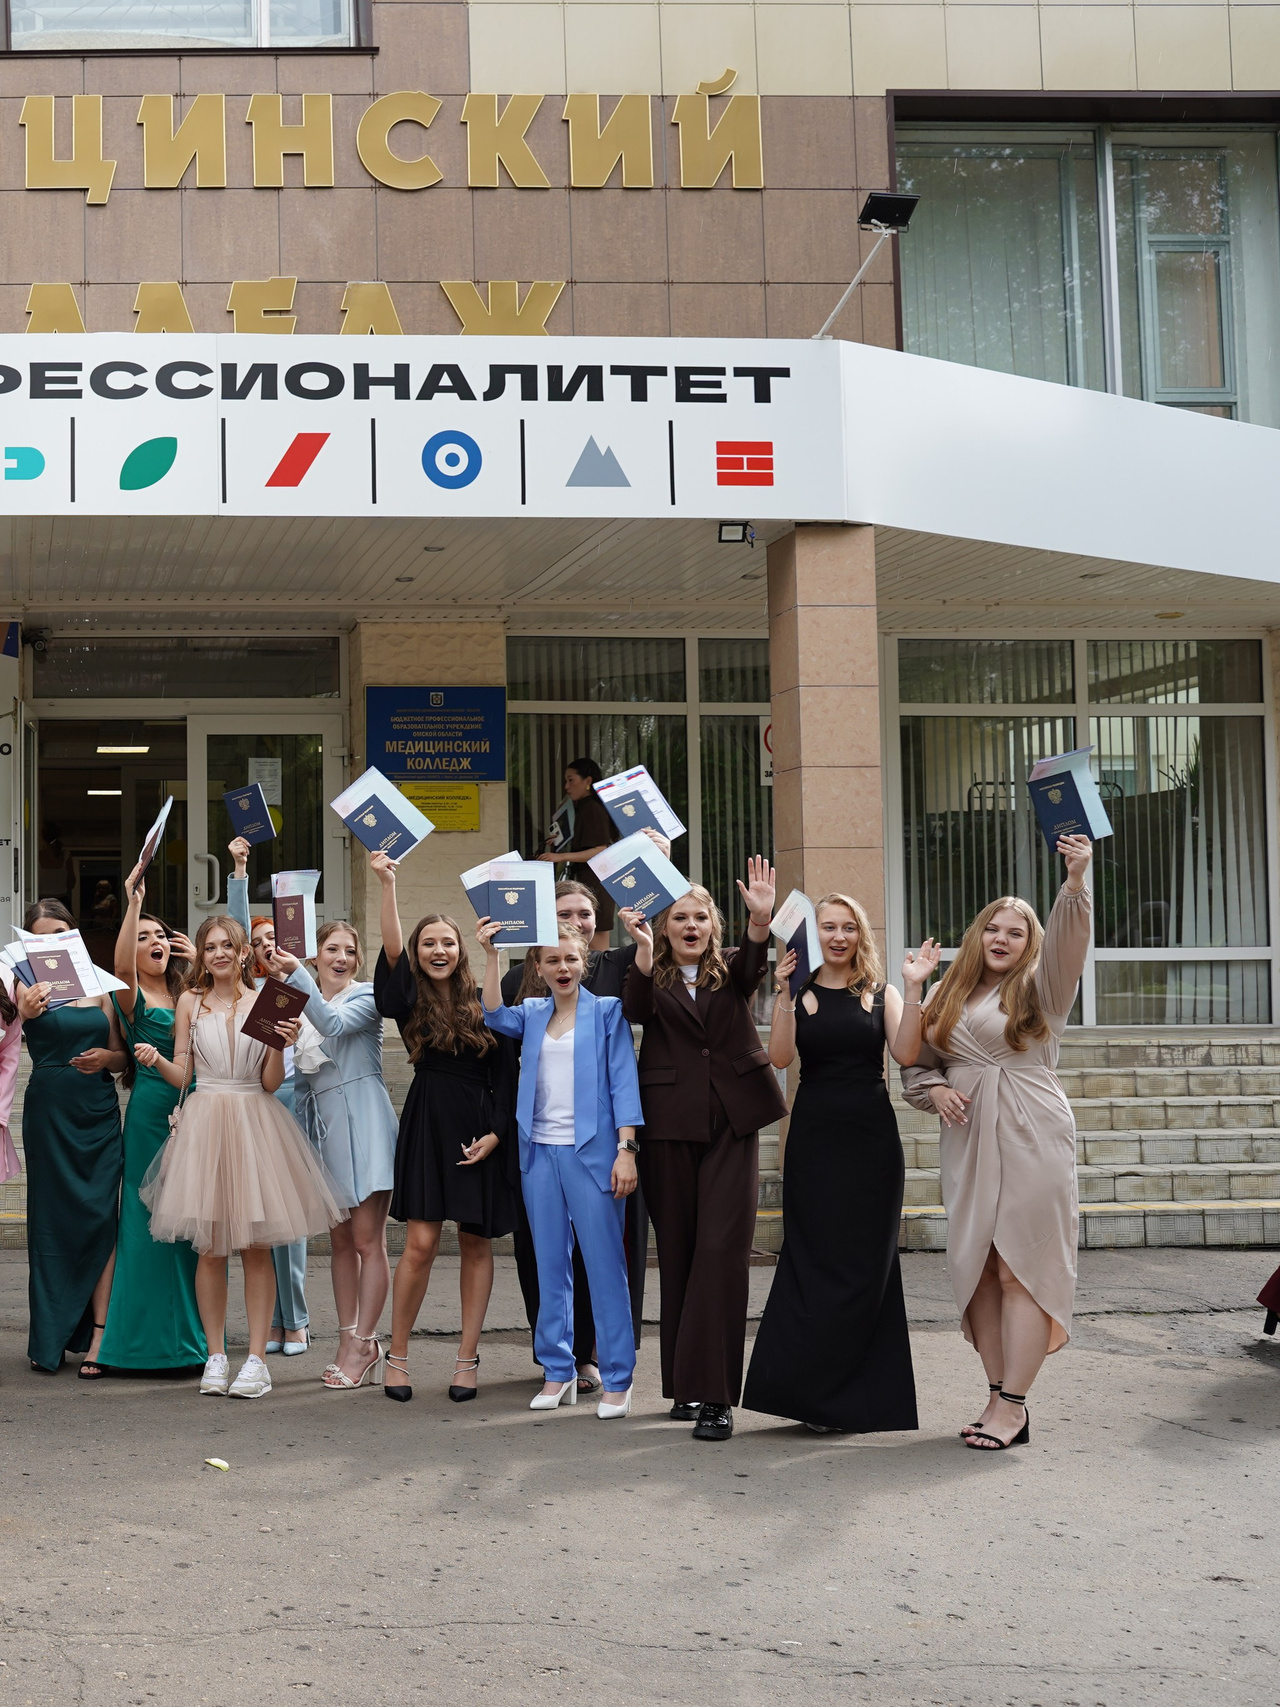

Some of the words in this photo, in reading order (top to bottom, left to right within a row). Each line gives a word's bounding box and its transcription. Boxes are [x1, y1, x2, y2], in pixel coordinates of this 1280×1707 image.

[390, 715, 424, 723] БЮДЖЕТНОЕ
[385, 738, 490, 755] МЕДИЦИНСКИЙ
[406, 757, 472, 771] КОЛЛЕДЖ
